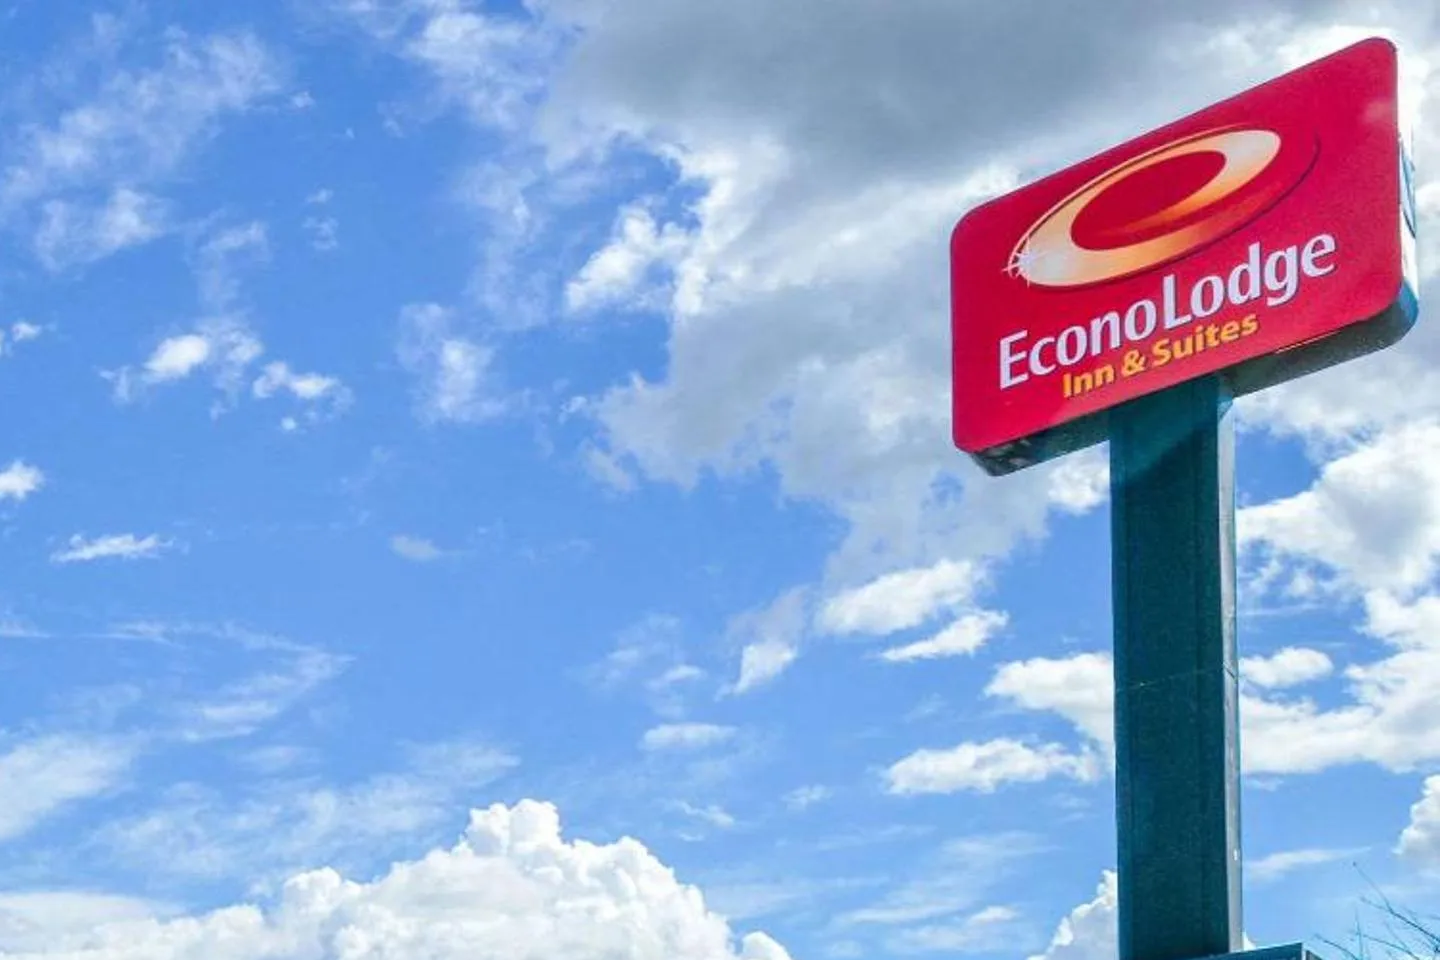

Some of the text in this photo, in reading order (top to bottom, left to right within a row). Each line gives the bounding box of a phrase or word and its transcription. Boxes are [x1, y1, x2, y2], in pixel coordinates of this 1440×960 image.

[999, 233, 1338, 389] EconoLodge
[1062, 313, 1260, 398] Inn & Suites
